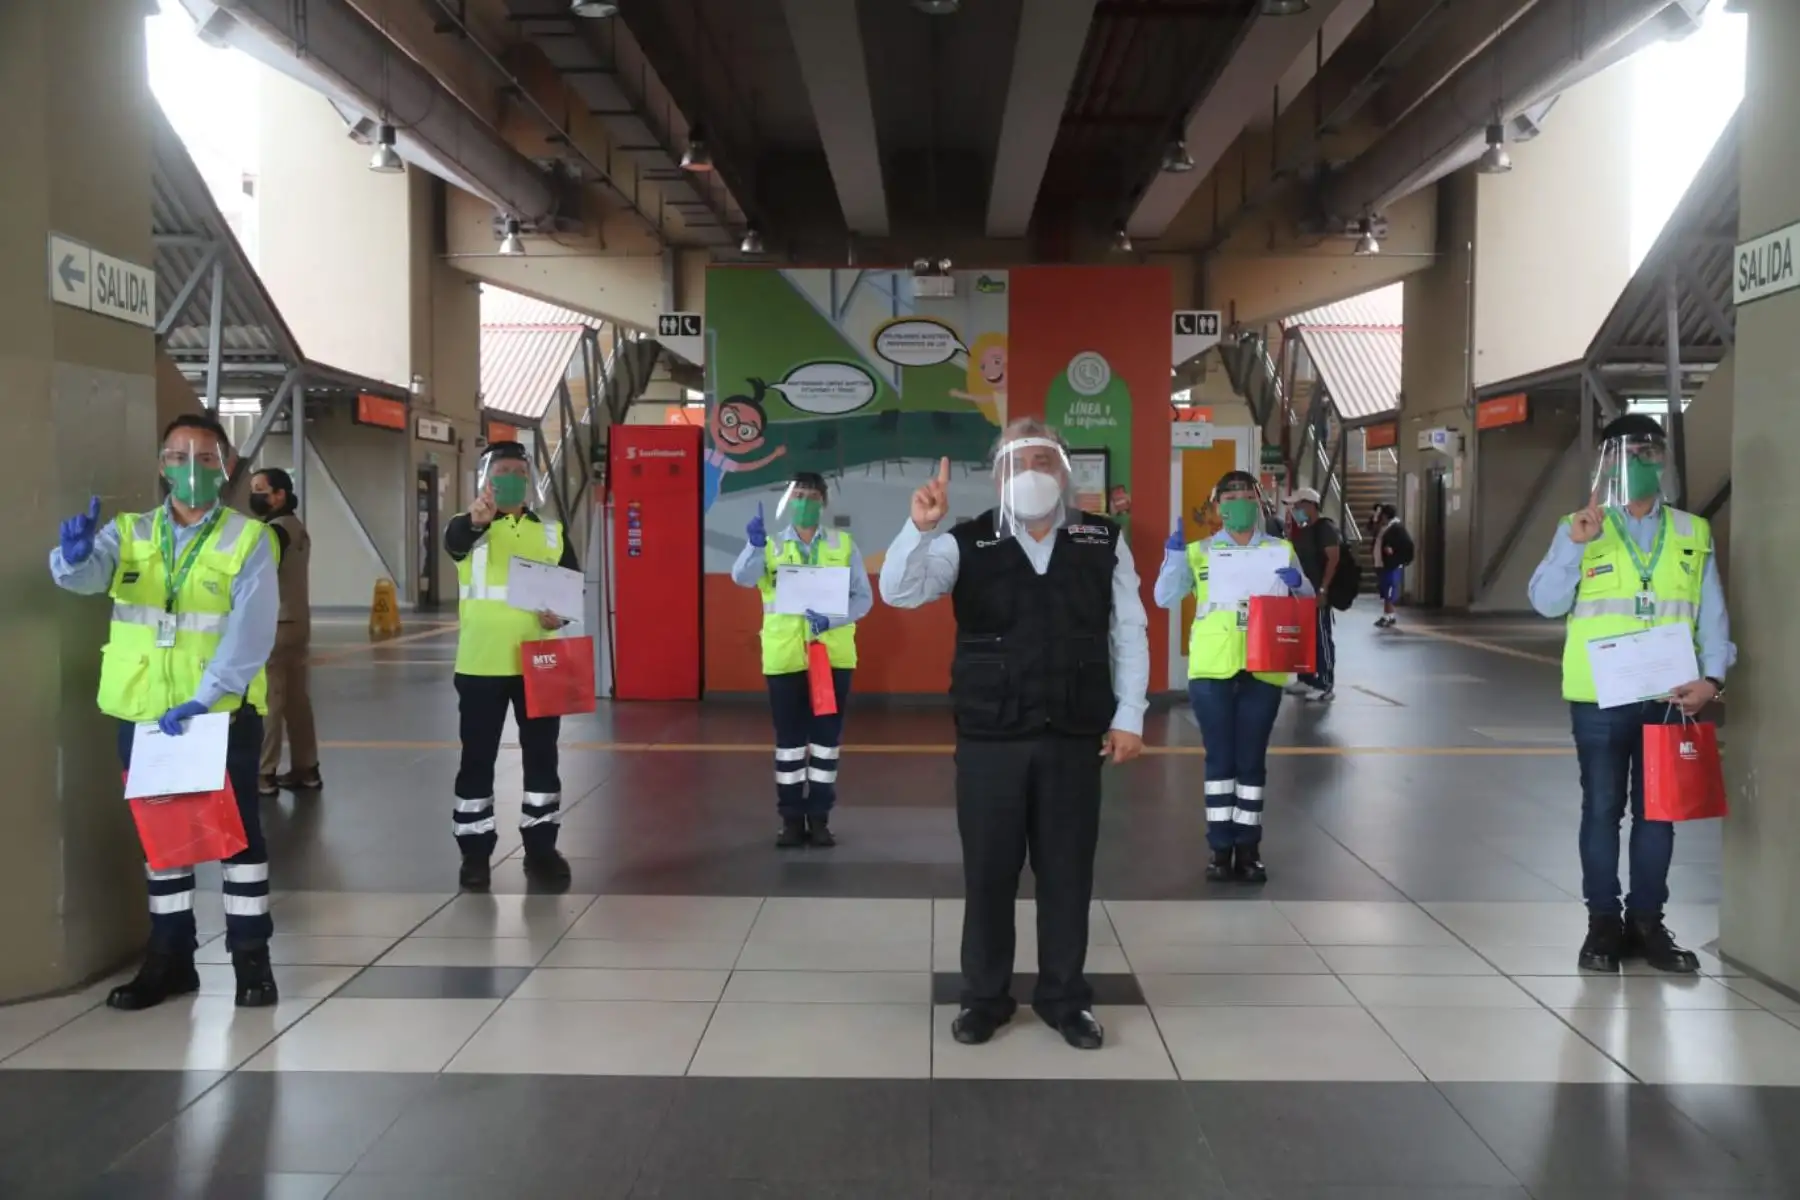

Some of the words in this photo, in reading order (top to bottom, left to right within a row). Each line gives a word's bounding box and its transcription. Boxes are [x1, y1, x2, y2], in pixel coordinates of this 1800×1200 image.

[97, 262, 149, 316] SALIDA
[1739, 236, 1793, 292] SALIDA
[533, 653, 557, 665] MTC
